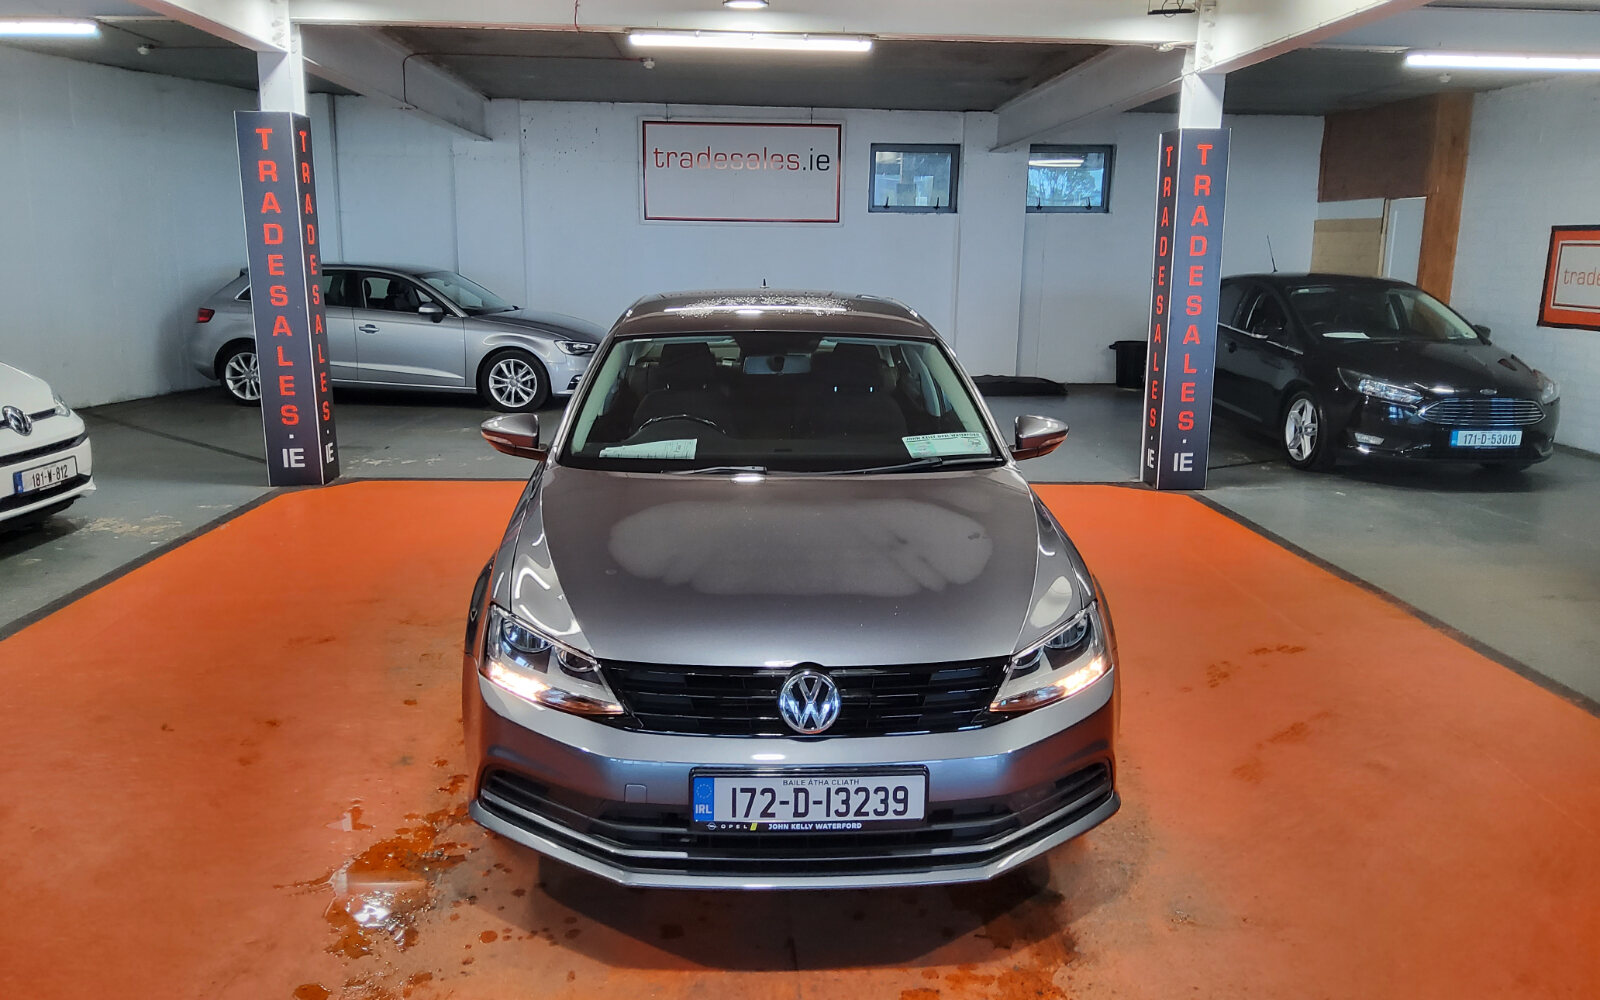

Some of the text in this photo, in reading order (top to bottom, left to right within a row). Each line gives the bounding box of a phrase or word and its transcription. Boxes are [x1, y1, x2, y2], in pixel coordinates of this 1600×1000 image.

[652, 146, 831, 172] tradesales.ie
[1463, 433, 1517, 445] 171-D-53010
[32, 464, 68, 488] 181-W-812
[783, 777, 860, 786] BAILE ÁTHA CLIATH
[731, 786, 909, 819] 172-D-13239
[695, 804, 713, 814] IRL
[768, 822, 862, 831] JOHN KELLY WATERFORD
